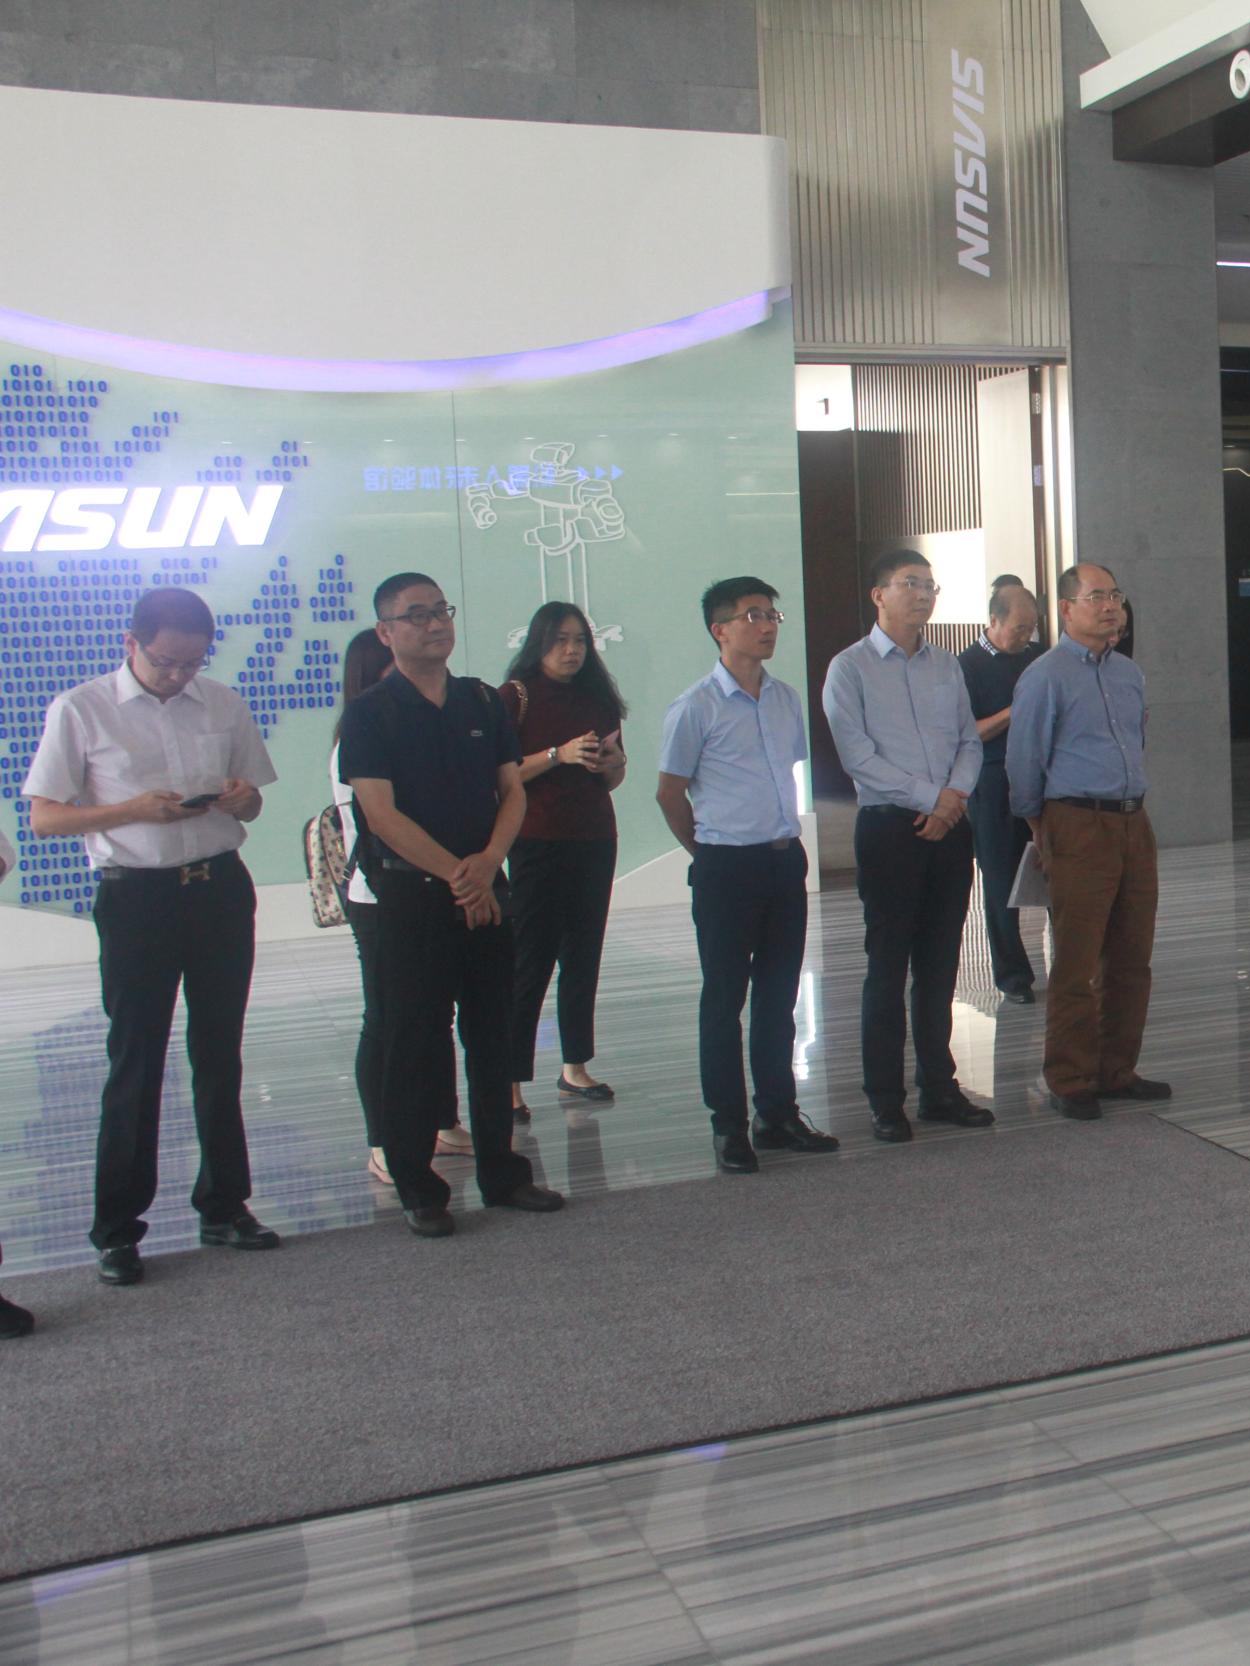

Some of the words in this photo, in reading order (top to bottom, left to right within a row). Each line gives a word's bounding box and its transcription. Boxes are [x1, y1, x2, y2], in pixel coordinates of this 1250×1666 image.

[951, 48, 991, 278] SIASUN
[10, 364, 42, 377] 010
[3, 379, 52, 392] 10101
[68, 380, 107, 393] 1010
[816, 398, 829, 415] 1
[153, 411, 179, 423] 101
[132, 425, 169, 437] 0101
[60, 441, 99, 453] 0101
[114, 440, 161, 452] 10101
[281, 440, 298, 452] 01
[214, 456, 242, 467] 010
[272, 455, 308, 467] 0101
[196, 470, 241, 482] 10101
[255, 470, 292, 482] 1010
[161, 558, 190, 569] 010
[201, 557, 217, 569] 01
[278, 555, 288, 567] 0
[335, 554, 344, 566] 0
[270, 569, 286, 582] 01
[319, 568, 343, 580] 101
[261, 583, 297, 596] 0101
[318, 581, 352, 594] 0101
[252, 597, 300, 610] 01010
[309, 595, 344, 608] 0101
[313, 609, 355, 622] 10101
[215, 629, 225, 641] 0
[264, 627, 292, 639] 010
[207, 644, 216, 656] 0
[255, 641, 284, 654] 010
[305, 639, 328, 651] 101
[247, 656, 275, 669] 010
[304, 653, 339, 665] 0101
[238, 670, 273, 683] 0101
[295, 668, 330, 680] 0101
[9, 741, 39, 753] 010
[263, 728, 269, 739] 1
[0, 756, 31, 769] 010
[0, 771, 28, 784] 10
[2, 786, 21, 799] 01
[15, 800, 32, 813] 01
[74, 901, 91, 913] 01
